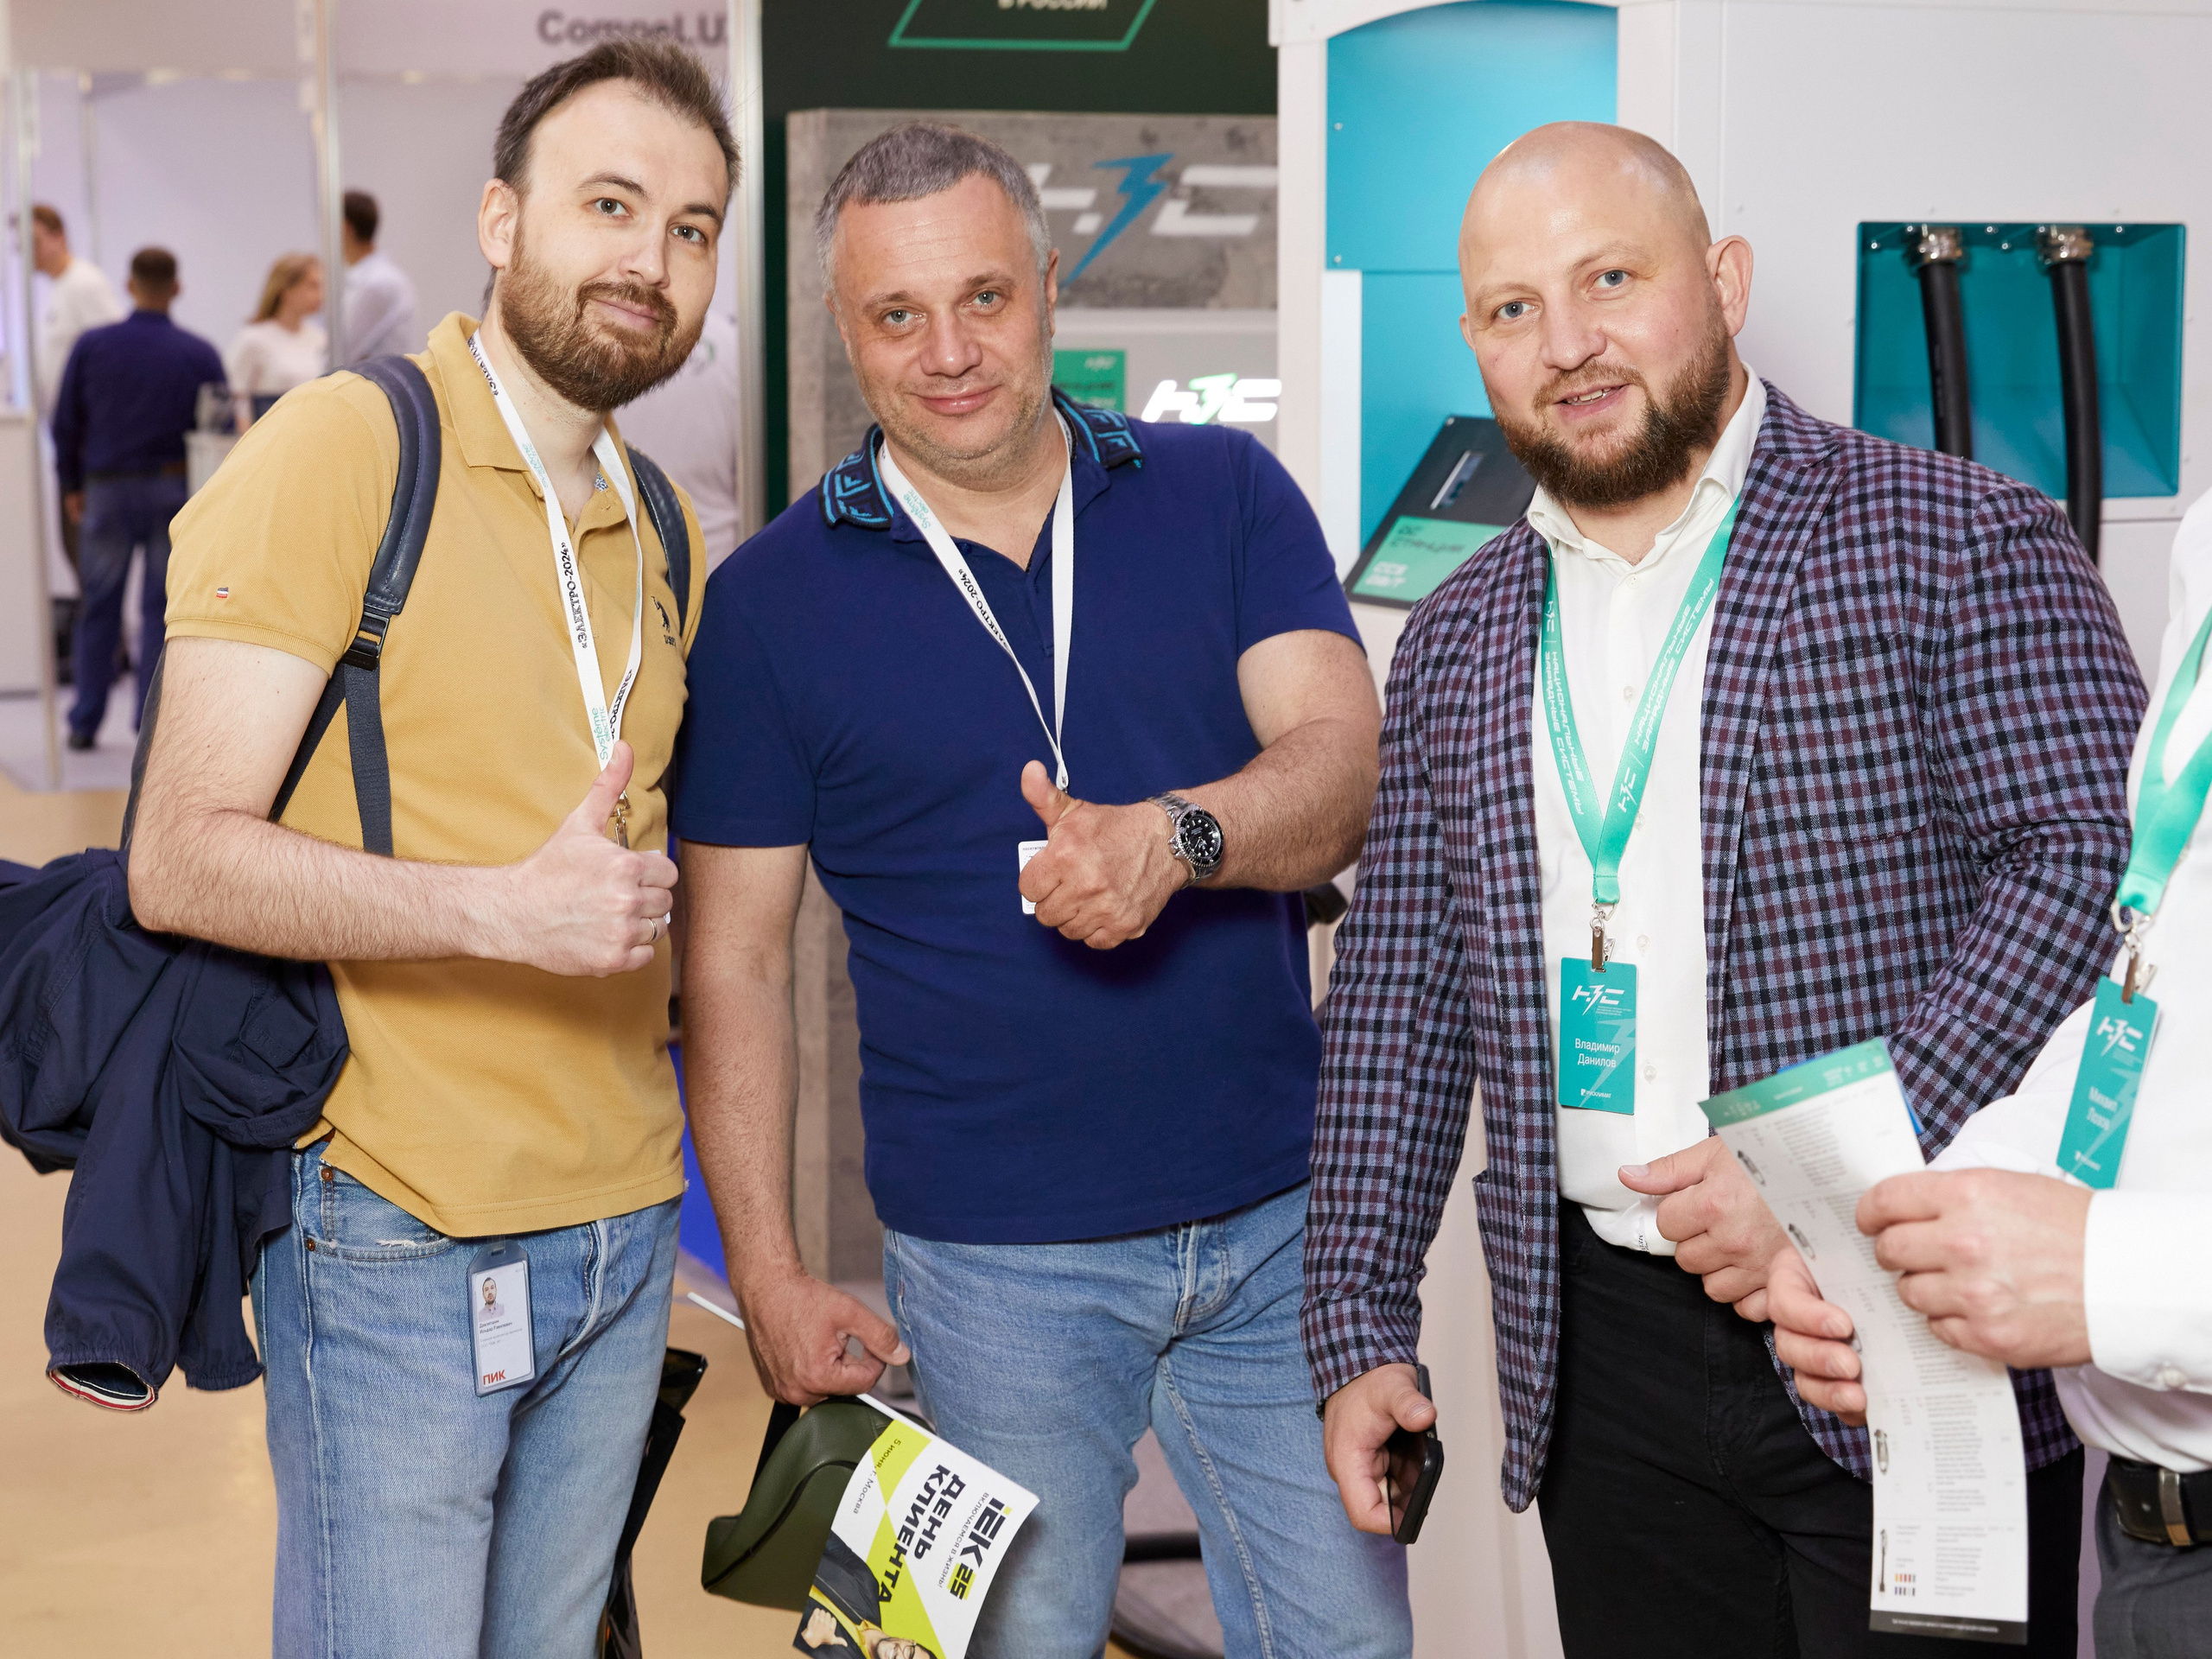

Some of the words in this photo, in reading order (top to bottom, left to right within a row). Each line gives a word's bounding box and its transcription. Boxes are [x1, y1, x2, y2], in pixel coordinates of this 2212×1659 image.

[1675, 577, 1714, 656] СИСТЕМЫ
[1634, 603, 1693, 746] НАЦИОНАЛЬНЫЕ
[601, 705, 612, 742] electric
[1552, 651, 1585, 782] НАЦИОНАЛЬНЫЕ
[1556, 736, 1585, 816] СИСТЕМЫ
[1574, 1038, 1621, 1054] Владимир
[1577, 1053, 1618, 1068] Данилов
[483, 1370, 506, 1385] ПИК
[874, 1445, 895, 1469] июня,
[853, 1478, 874, 1515] Москва
[880, 1464, 951, 1603] КЛИЕНТА
[914, 1473, 966, 1560] ДЕНЬ
[953, 1491, 989, 1548] ВКЛЮЧАЕМСЯ
[938, 1554, 955, 1588] ЖИЗНЬ!
[950, 1562, 975, 1600] 25
